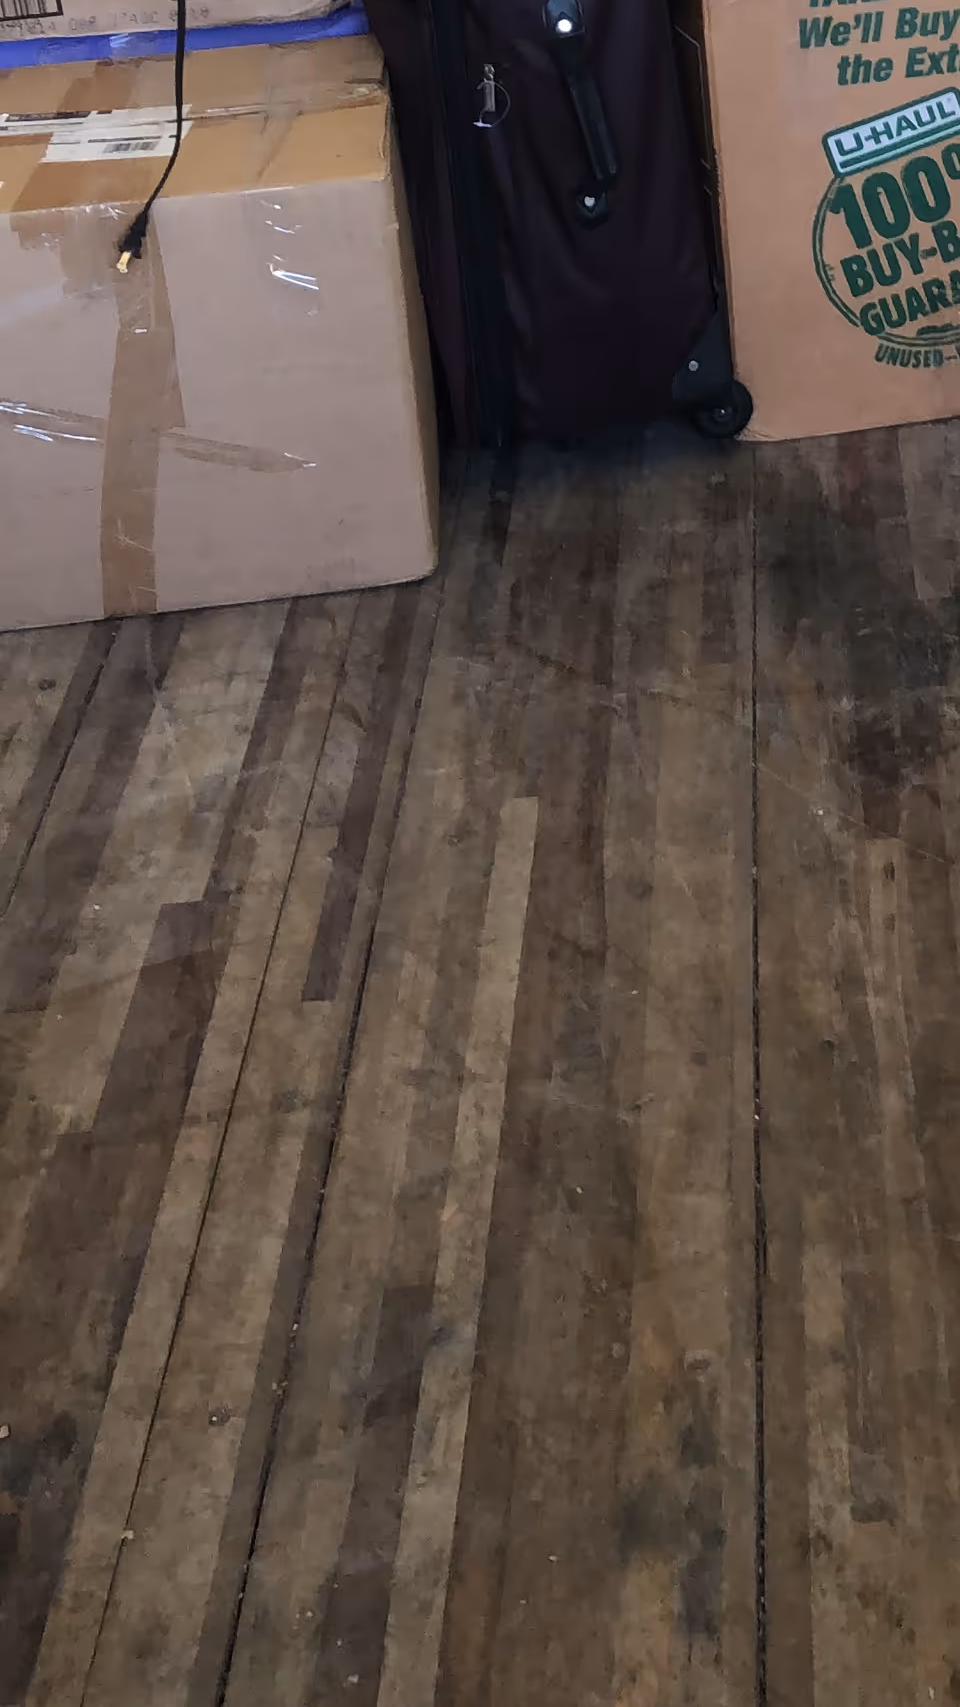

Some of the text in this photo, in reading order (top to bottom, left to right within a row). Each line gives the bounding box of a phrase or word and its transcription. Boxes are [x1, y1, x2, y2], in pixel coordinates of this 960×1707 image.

[799, 11, 885, 49] We'll
[895, 6, 960, 41] Buy
[837, 54, 893, 86] the
[834, 100, 957, 157] U-HAUL
